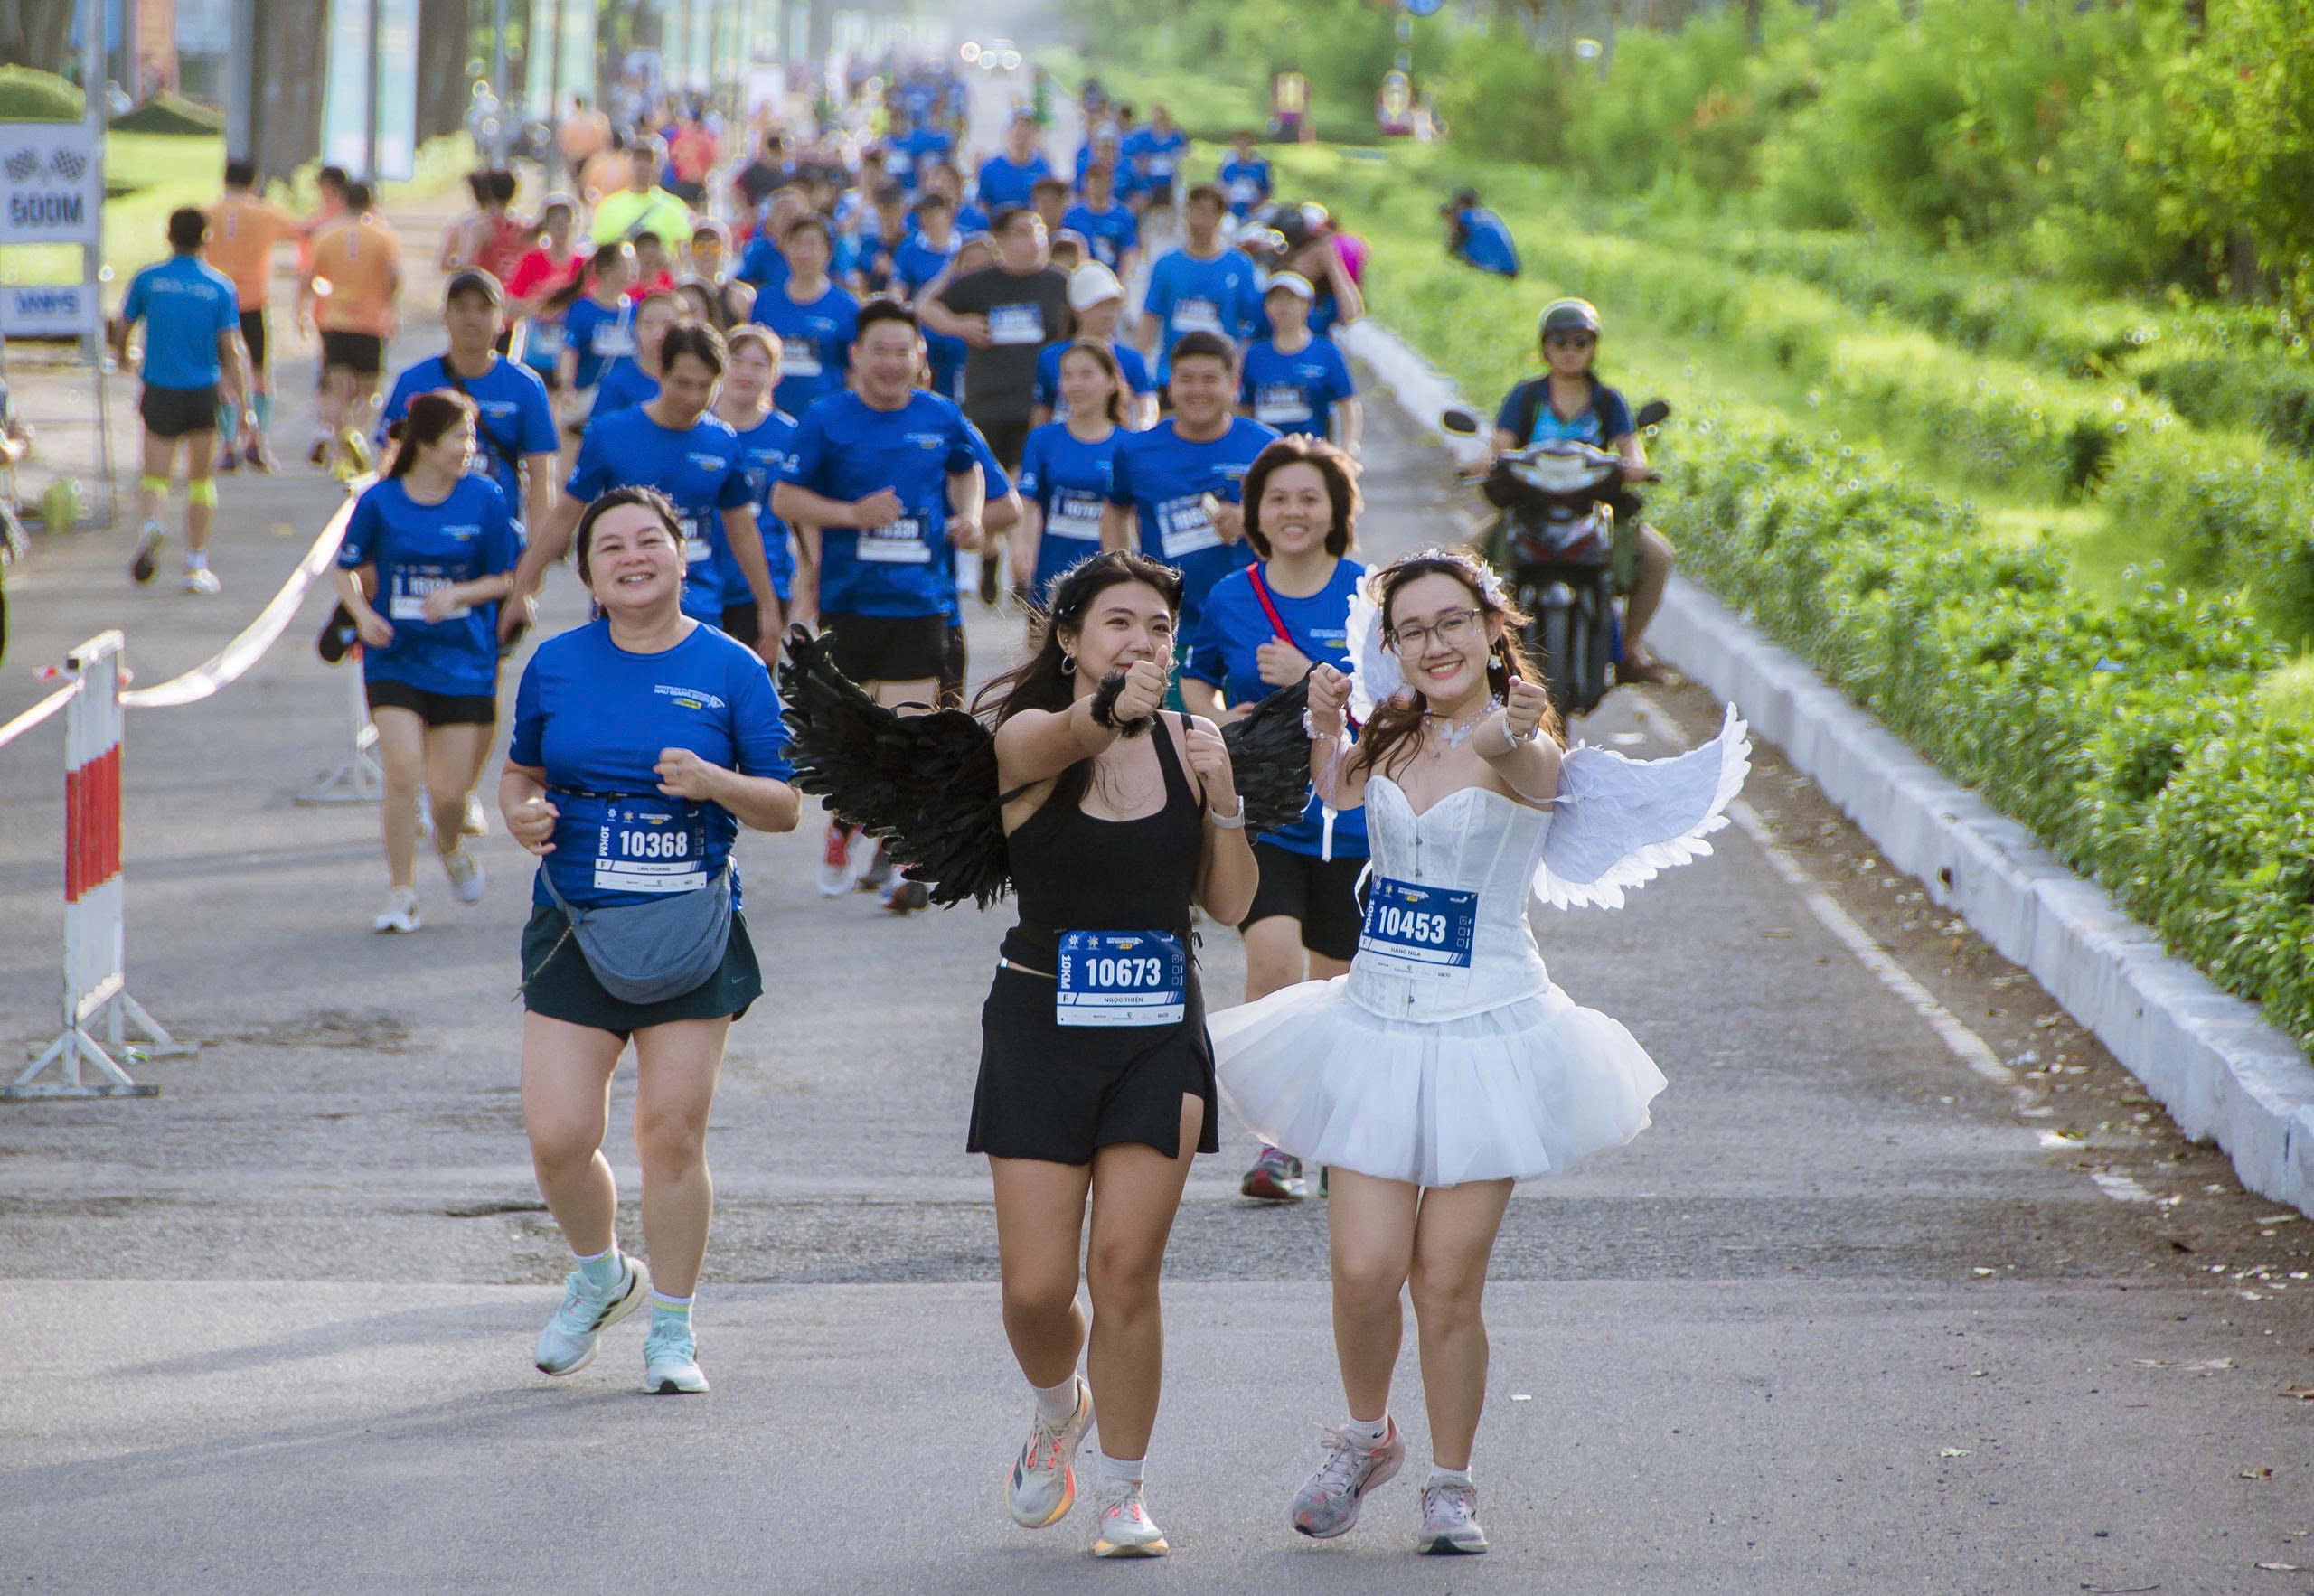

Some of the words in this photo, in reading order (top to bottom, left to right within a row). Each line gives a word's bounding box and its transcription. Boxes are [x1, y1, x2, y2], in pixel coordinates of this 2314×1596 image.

[9, 192, 83, 224] 500M
[599, 825, 610, 857] 10KM
[619, 830, 688, 858] 10368
[1364, 899, 1375, 934] 10KM
[1378, 905, 1446, 944] 10453
[1060, 954, 1072, 990] 10KM
[1086, 957, 1161, 987] 10673
